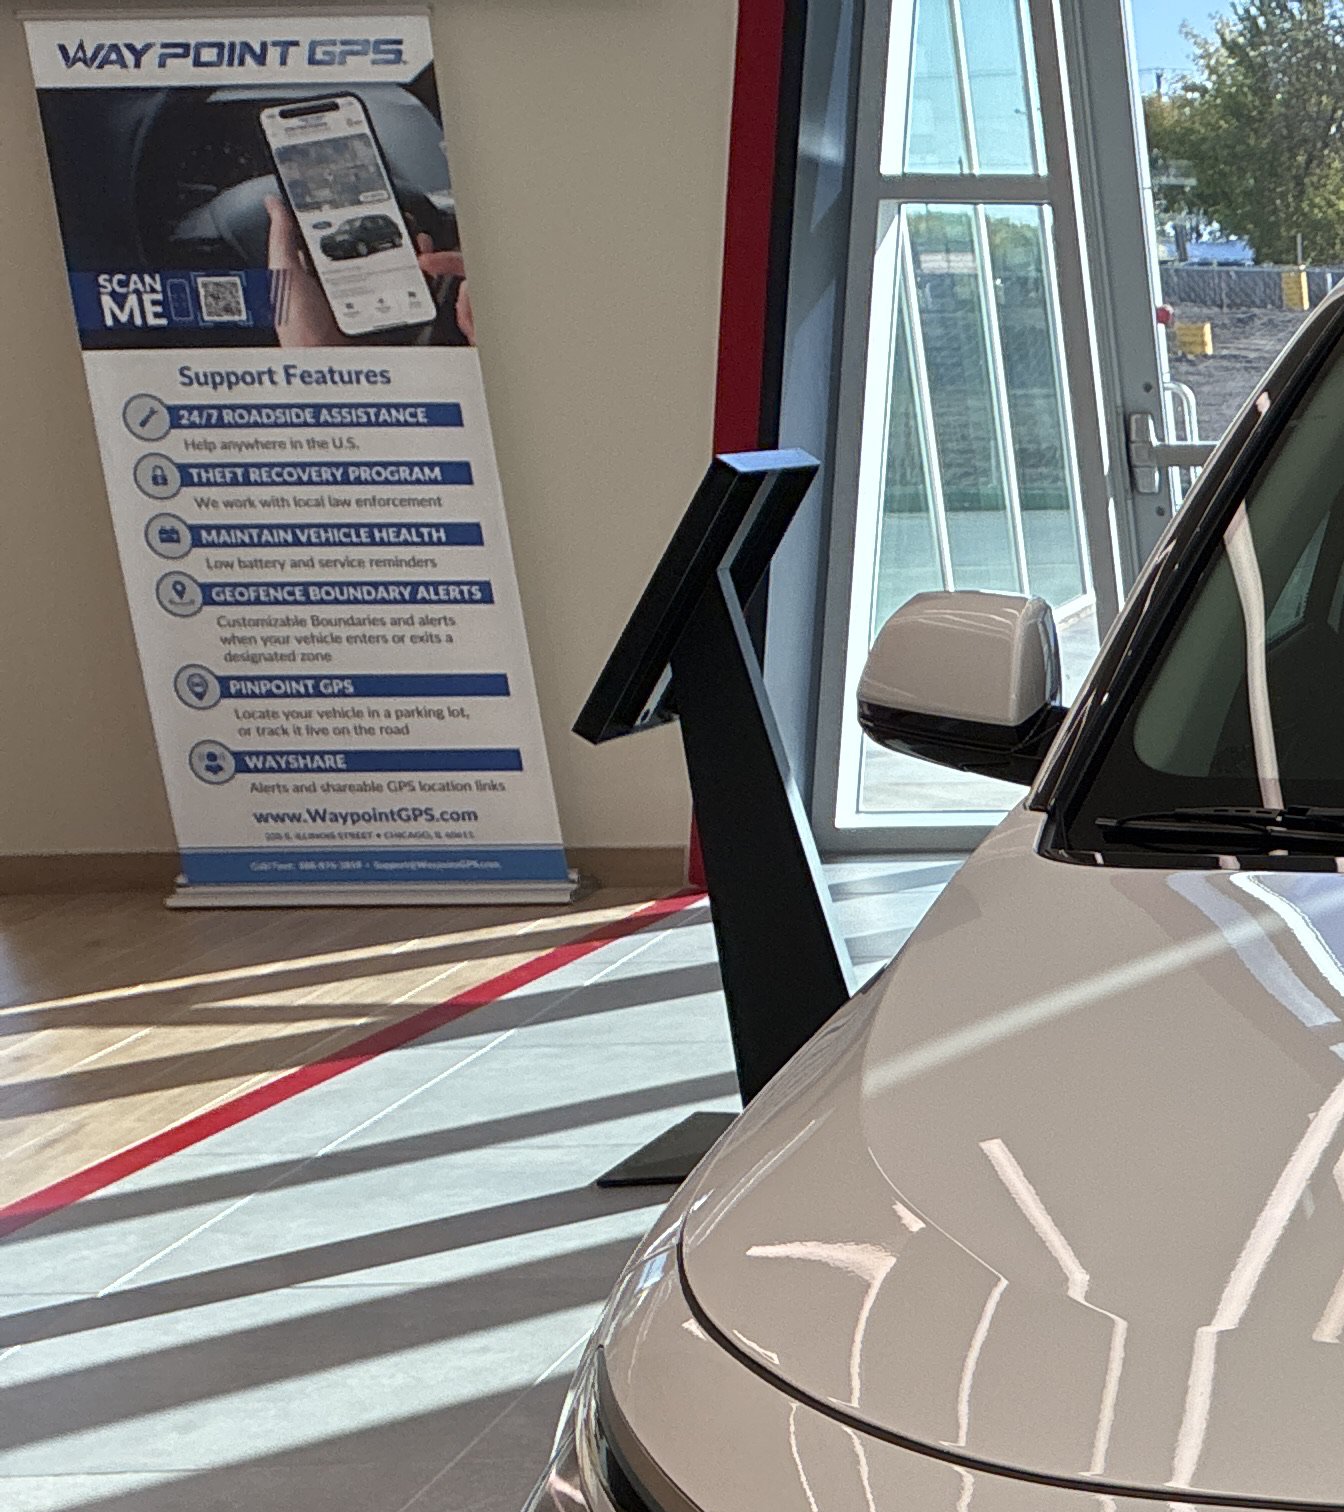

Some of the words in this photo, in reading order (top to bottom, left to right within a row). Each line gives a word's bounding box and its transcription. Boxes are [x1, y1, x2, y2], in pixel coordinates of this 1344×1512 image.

[57, 38, 300, 69] WAYPOINT
[308, 38, 404, 66] GPS
[98, 273, 162, 293] SCAN
[100, 293, 169, 327] ME
[179, 365, 278, 390] Support
[283, 364, 392, 386] Features
[178, 409, 218, 425] 24/7
[223, 408, 315, 424] ROADSIDE
[319, 407, 428, 423] ASSISTANCE
[184, 439, 217, 452] Help
[220, 438, 287, 452] anywhere
[290, 438, 303, 450] in
[306, 438, 329, 450] the
[332, 437, 360, 450] U.S.
[190, 467, 245, 483] THEFT
[250, 467, 344, 483] RECOVERY
[349, 467, 442, 482] PROGRAM
[194, 497, 219, 510] We
[223, 497, 257, 509] work
[260, 496, 289, 508] with
[293, 496, 325, 509] local
[328, 496, 352, 508] law
[355, 495, 442, 508] enforcement
[201, 528, 294, 544] MAINTAIN
[295, 528, 371, 543] VEHICLE
[374, 527, 446, 543] HEALTH
[205, 557, 234, 570] Low
[238, 557, 286, 572] battery
[290, 557, 315, 569] and
[319, 557, 366, 569] service
[369, 556, 438, 569] reminders
[211, 587, 305, 602] GEOFENCE
[309, 586, 412, 601] BOUNDARY
[416, 585, 482, 600] ALERTS
[216, 615, 307, 629] Customizable
[311, 615, 387, 628] Boundaries
[390, 614, 415, 627] and
[418, 614, 456, 627] alerts
[220, 634, 258, 647] when
[261, 635, 291, 649] your
[295, 633, 343, 646] vehicle
[346, 633, 388, 645] enters
[392, 635, 406, 645] or
[409, 632, 442, 645] exits
[445, 635, 454, 644] a
[224, 650, 296, 665] designated
[300, 653, 333, 664] zone
[230, 679, 315, 695] PINPOINT
[319, 679, 354, 694] GPS
[234, 708, 280, 720] Locate
[282, 709, 313, 723] your
[316, 707, 364, 719] vehicle
[367, 707, 380, 719] in
[383, 709, 392, 719] a
[395, 706, 445, 722] parking
[448, 706, 470, 720] lot,
[237, 726, 252, 737] or
[255, 725, 289, 737] track
[293, 725, 301, 736] it
[305, 724, 330, 736] live
[333, 726, 350, 736] on
[353, 724, 375, 736] the
[379, 724, 410, 736] road
[245, 754, 347, 770] WAYSHARE
[251, 781, 288, 794] Alerts
[292, 781, 317, 793] and
[320, 781, 384, 793] shareable
[387, 781, 416, 793] GPS
[419, 780, 472, 793] location
[474, 780, 506, 792] links
[253, 807, 479, 826] www.WaypointGPS.com
